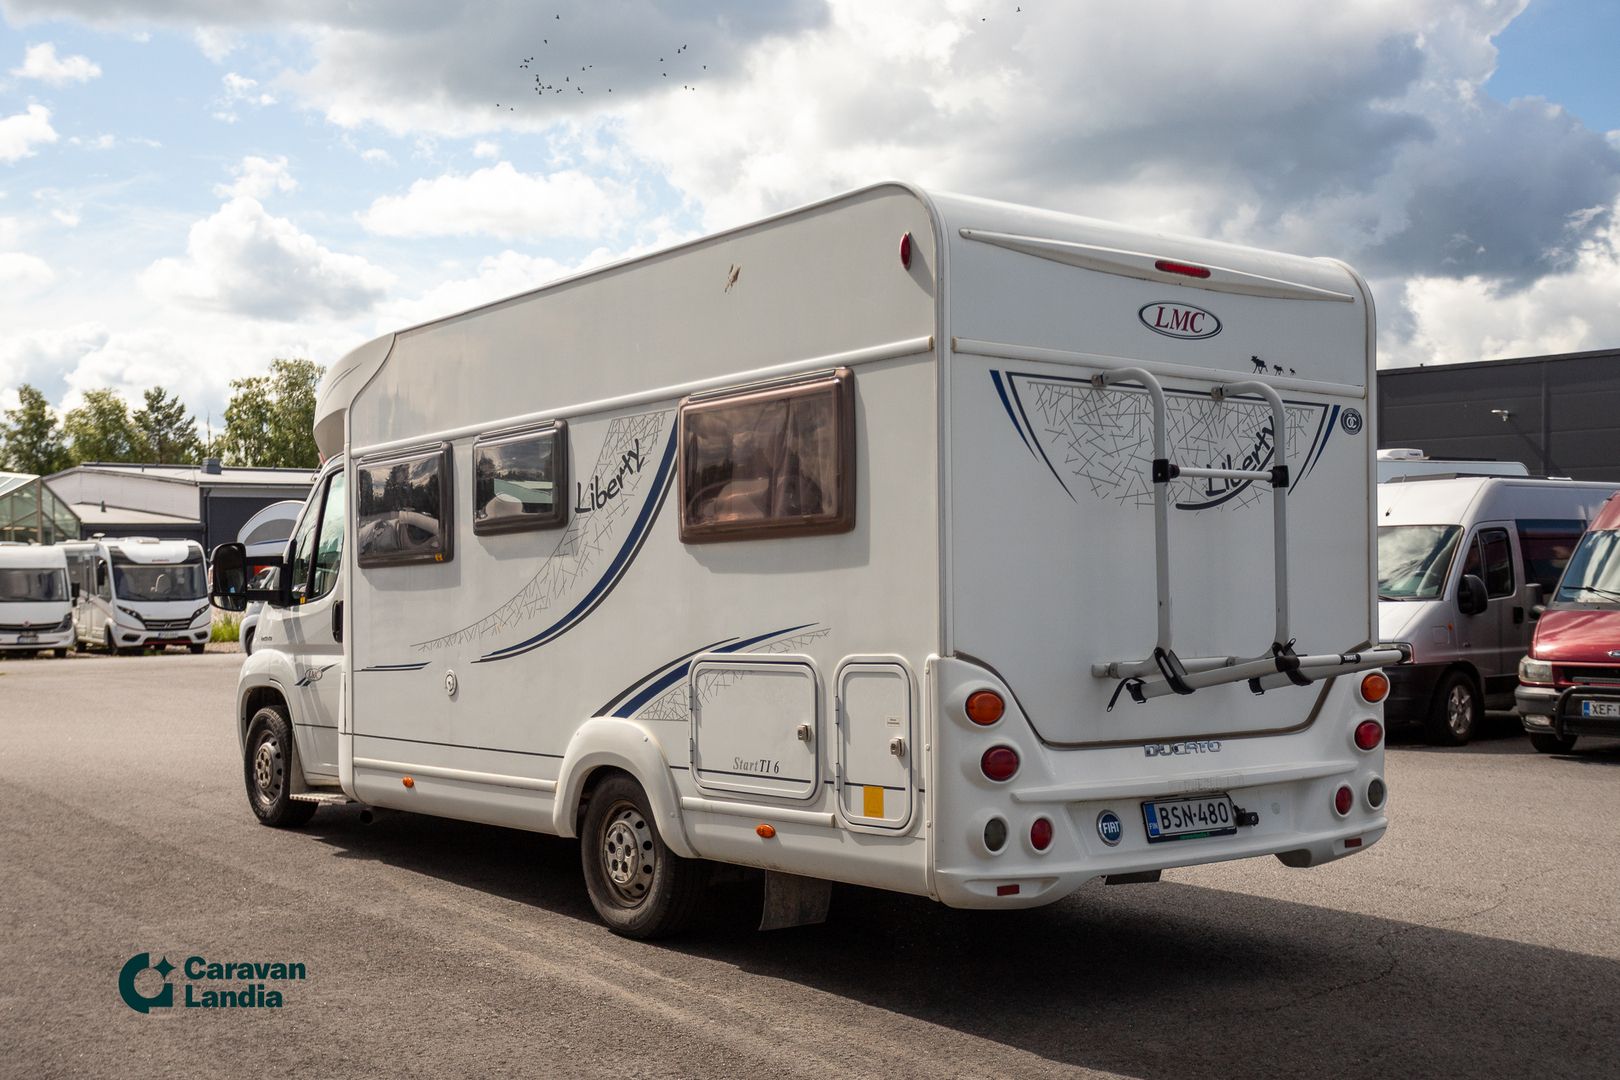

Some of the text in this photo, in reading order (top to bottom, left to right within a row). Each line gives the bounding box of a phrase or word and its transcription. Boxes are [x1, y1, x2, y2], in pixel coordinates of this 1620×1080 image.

[1154, 305, 1206, 334] LMC
[574, 438, 646, 514] Liberty
[1592, 704, 1620, 716] XEF-
[1144, 740, 1222, 757] DUCATO
[773, 760, 780, 775] 6
[1158, 802, 1229, 829] BSN-480
[1102, 821, 1120, 834] FIAT
